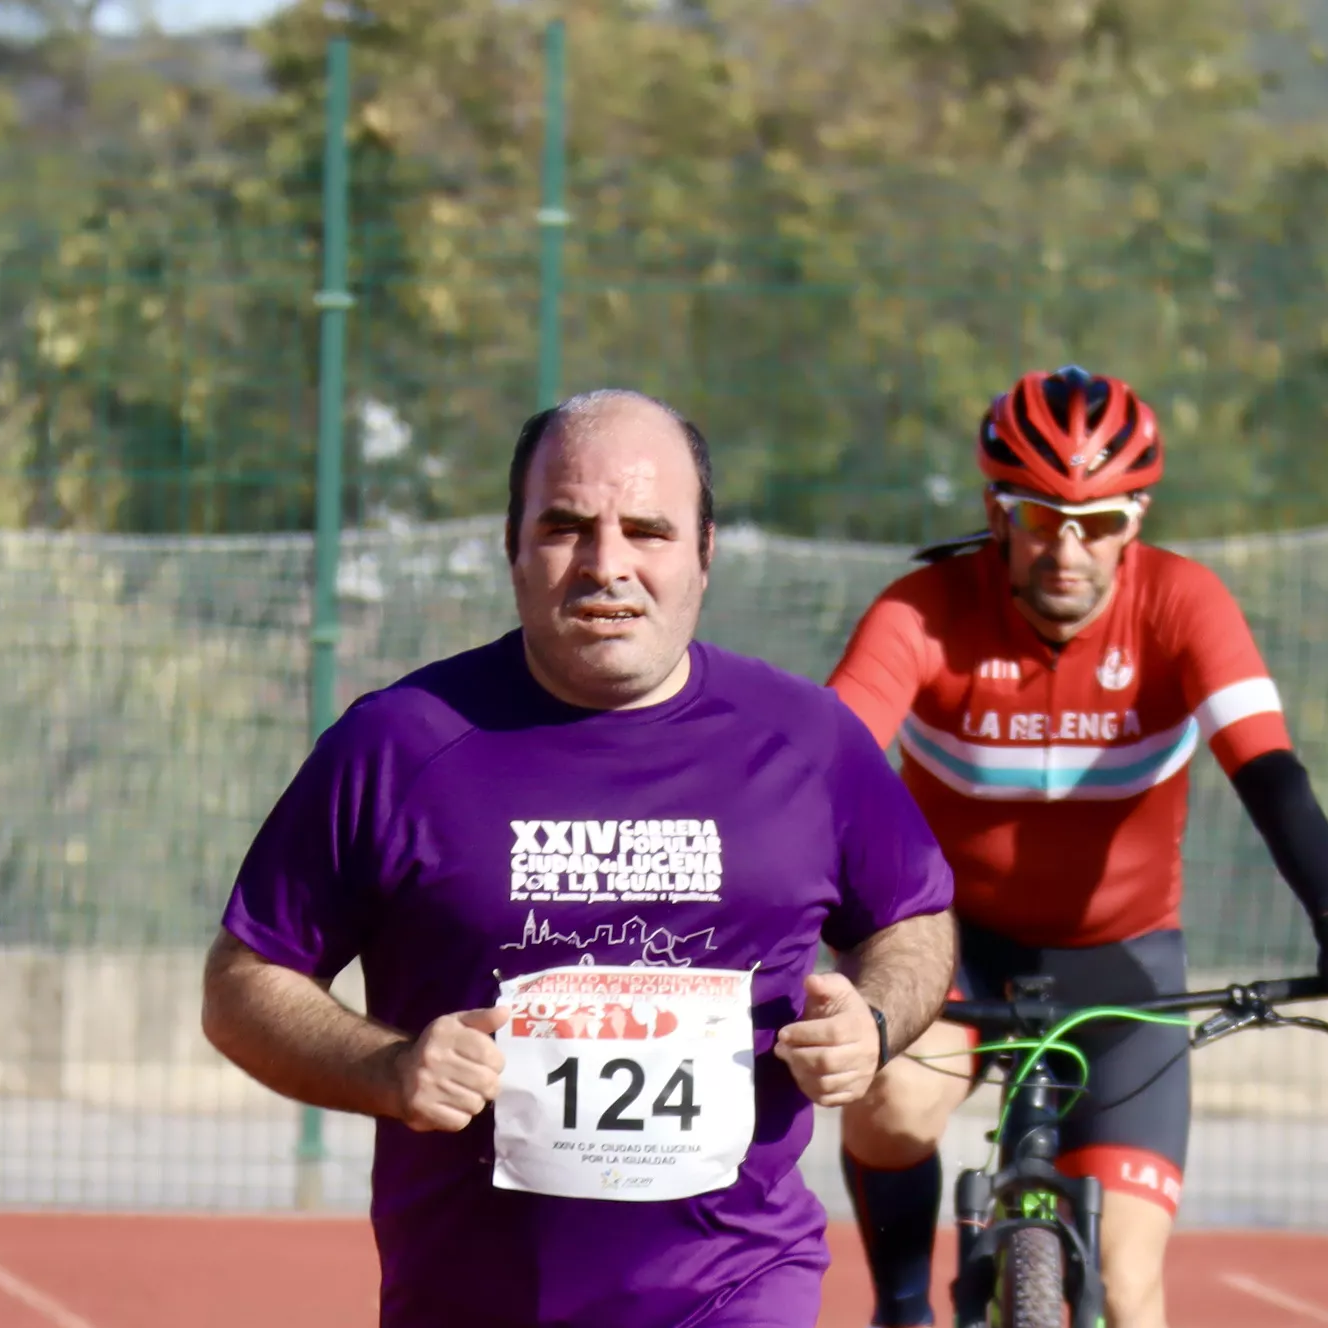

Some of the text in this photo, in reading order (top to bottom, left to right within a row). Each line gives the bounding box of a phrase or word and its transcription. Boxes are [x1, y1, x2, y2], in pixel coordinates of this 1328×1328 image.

[963, 711, 1000, 740] LA
[509, 820, 618, 854] XXIV
[618, 819, 718, 836] CARRERA
[619, 836, 722, 854] POPULAR
[510, 853, 600, 873] CIUDAD
[617, 853, 723, 874] LUCENA
[511, 873, 722, 892] POR LA IGUALDAD
[510, 1001, 606, 1019] 2023
[546, 1057, 702, 1131] 124
[552, 1141, 575, 1150] XXIV
[601, 1143, 641, 1153] CIUDAD
[644, 1144, 657, 1153] DE
[660, 1144, 702, 1153] LUCENA
[581, 1154, 677, 1165] POR LA IGUALDAD
[1121, 1162, 1158, 1190] LA
